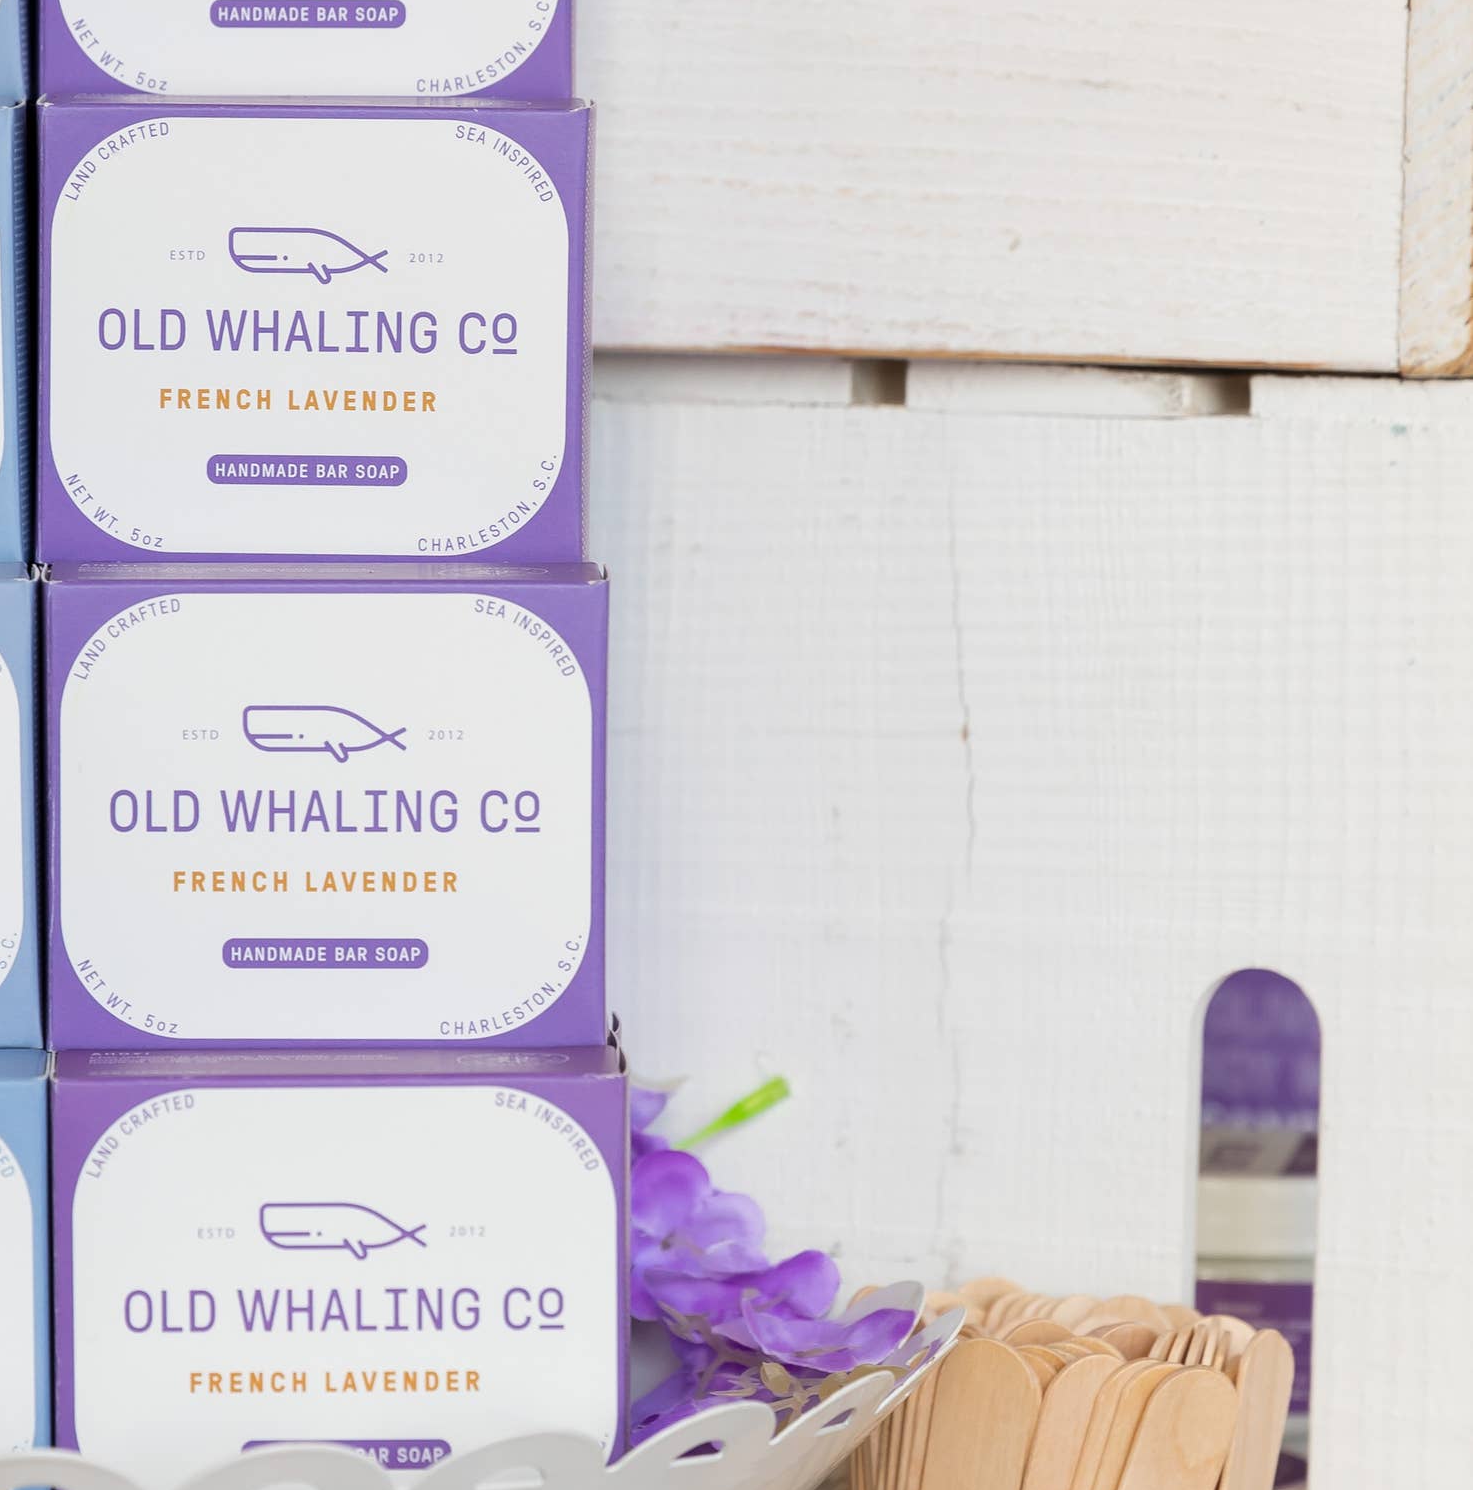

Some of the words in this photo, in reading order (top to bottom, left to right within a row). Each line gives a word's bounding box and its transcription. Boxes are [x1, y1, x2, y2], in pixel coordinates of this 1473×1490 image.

[218, 6, 309, 21] HANDMADE
[316, 7, 348, 22] BAR
[355, 7, 399, 22] SOAP
[71, 17, 100, 52] NET
[99, 51, 126, 78] WT.
[136, 71, 168, 91] 5oz
[416, 38, 534, 93] CHARLESTON,
[65, 159, 97, 202] LAND
[97, 121, 170, 161] CRAFTED
[455, 125, 486, 145] SEA
[492, 136, 554, 203] INSPIRED
[170, 250, 206, 260] ESTD
[409, 252, 444, 263] 2012
[99, 308, 186, 350] OLD
[206, 309, 437, 354] WHALING
[160, 389, 272, 410] FRENCH
[288, 390, 436, 412] LAVENDER
[215, 463, 308, 478] HANDMADE
[316, 464, 348, 479] BAR
[355, 464, 400, 480] SOAP
[65, 473, 95, 507] NET
[94, 505, 119, 533] WT.
[131, 528, 163, 548] 5oz
[418, 498, 539, 552] CHARLESTON,
[533, 453, 557, 491] S.C.
[73, 637, 106, 680] LAND
[108, 598, 181, 640] CRAFTED
[474, 598, 506, 619] SEA
[513, 610, 577, 678] INSPIRED
[182, 730, 220, 740] ESTD
[428, 730, 464, 740] 2012
[109, 789, 200, 832] OLD
[220, 789, 459, 833] WHALING
[173, 871, 288, 892] FRENCH
[306, 871, 458, 893] LAVENDER
[230, 946, 327, 962] HANDMADE
[334, 946, 368, 962] BAR
[375, 946, 421, 962] SOAP
[87, 1135, 118, 1179] LAND
[119, 1093, 196, 1136] CRAFTED
[495, 1092, 527, 1111] SEA
[534, 1103, 600, 1174] INSPIRED
[125, 1290, 216, 1333] OLD
[237, 1287, 481, 1333] WHALING
[190, 1372, 307, 1394] FRENCH
[325, 1370, 481, 1392] LAVENDER
